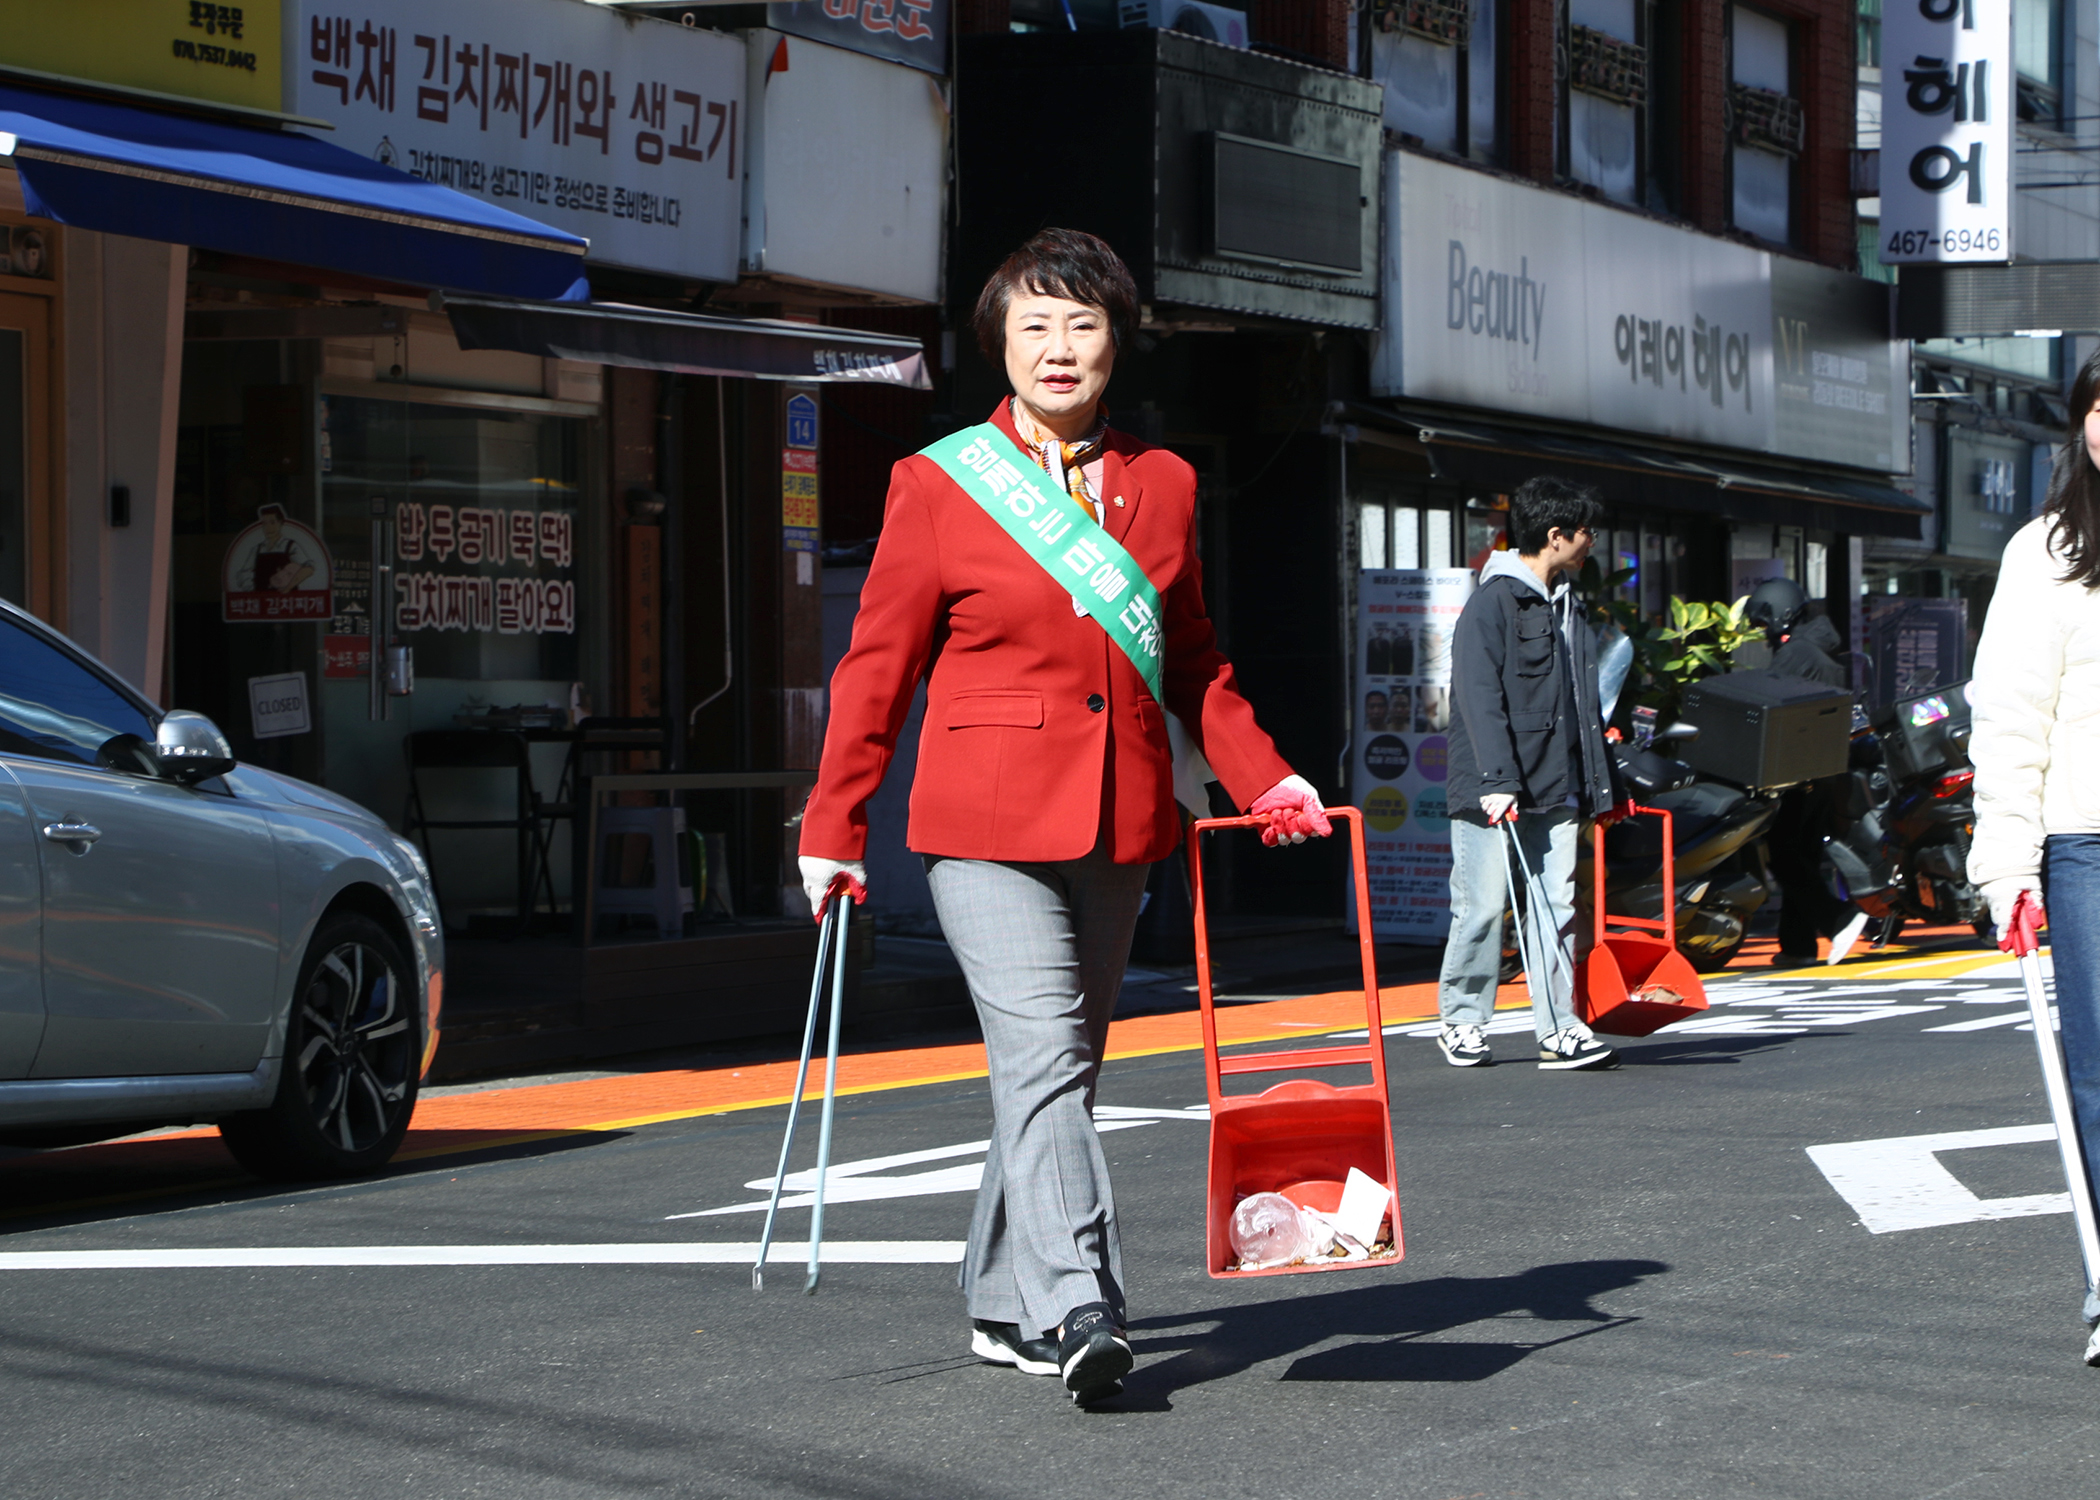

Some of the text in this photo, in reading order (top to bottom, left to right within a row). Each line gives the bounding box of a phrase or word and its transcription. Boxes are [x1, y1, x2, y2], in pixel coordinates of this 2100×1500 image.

[311, 14, 738, 180] 백채 김치찌개와 생고기
[408, 149, 682, 228] 김치찌개와 생고기만 정성으로 준비합니다
[1888, 228, 2000, 255] 467-6946
[1448, 239, 1546, 361] Beauty
[794, 419, 810, 441] 14
[397, 503, 427, 560] 밥
[957, 436, 1164, 673] 함께하는 마을 대청
[230, 595, 325, 615] 백채 김치찌개
[395, 571, 494, 632] 김치찌개
[497, 577, 574, 634] 팔아요!
[257, 697, 300, 716] CLOSED
